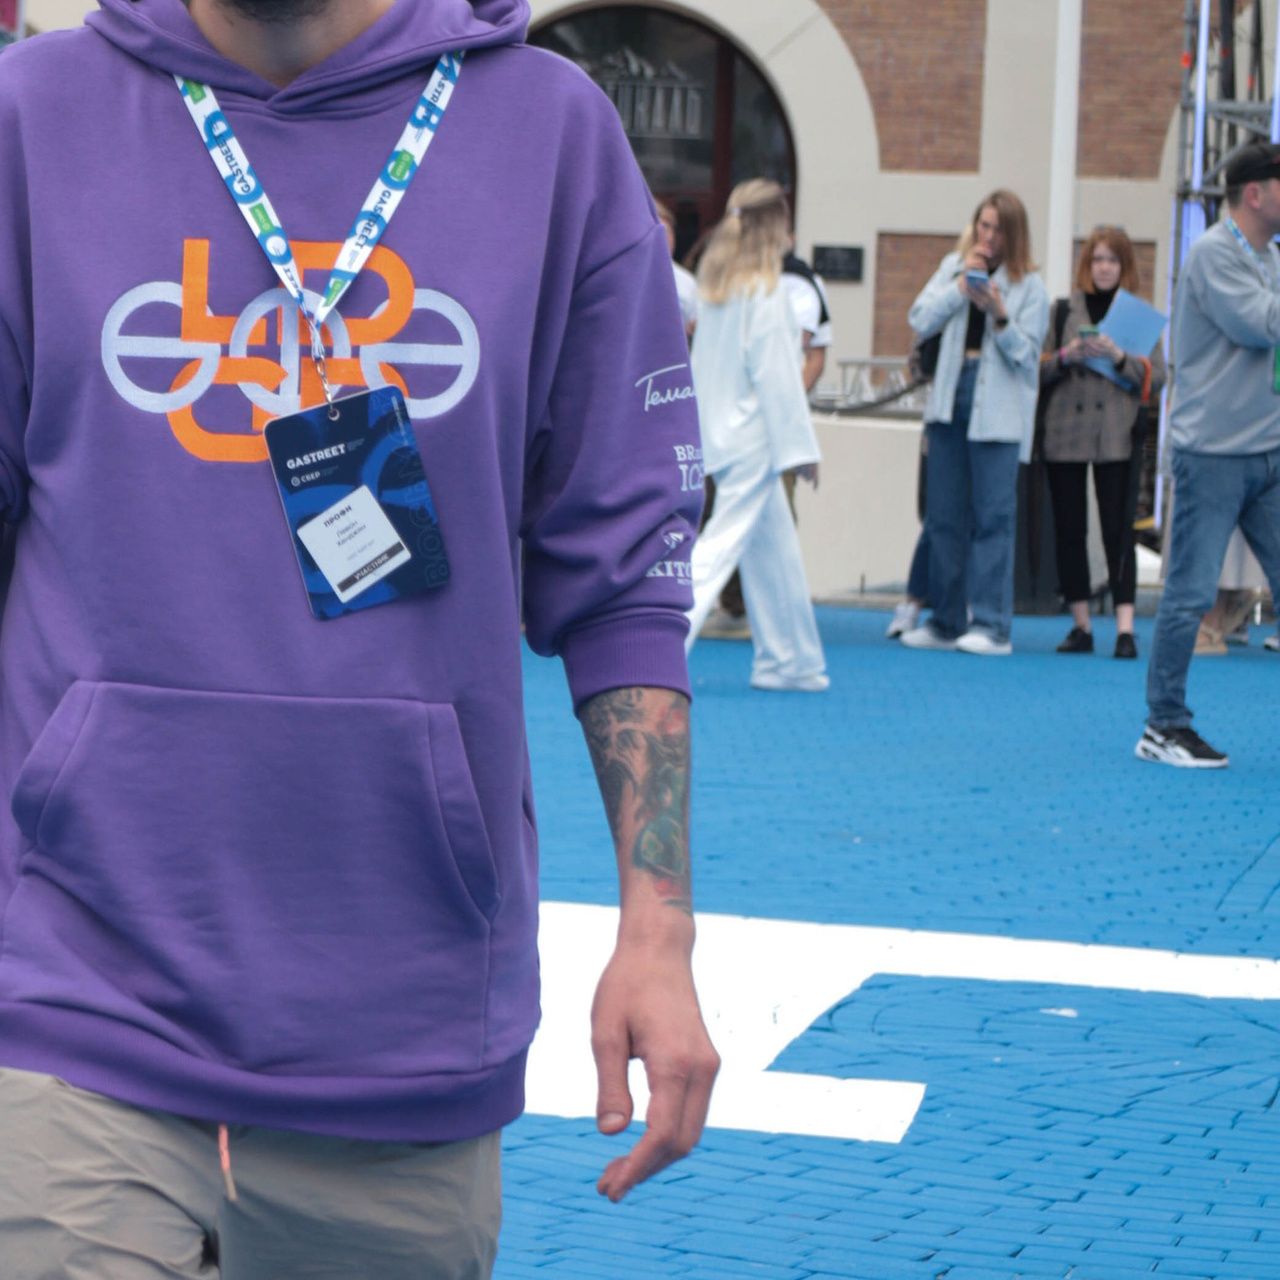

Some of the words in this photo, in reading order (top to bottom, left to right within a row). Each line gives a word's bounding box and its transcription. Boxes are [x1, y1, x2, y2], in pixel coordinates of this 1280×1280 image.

[214, 133, 251, 195] GASTREET
[354, 189, 392, 251] GASTREET
[286, 443, 346, 470] GASTREET
